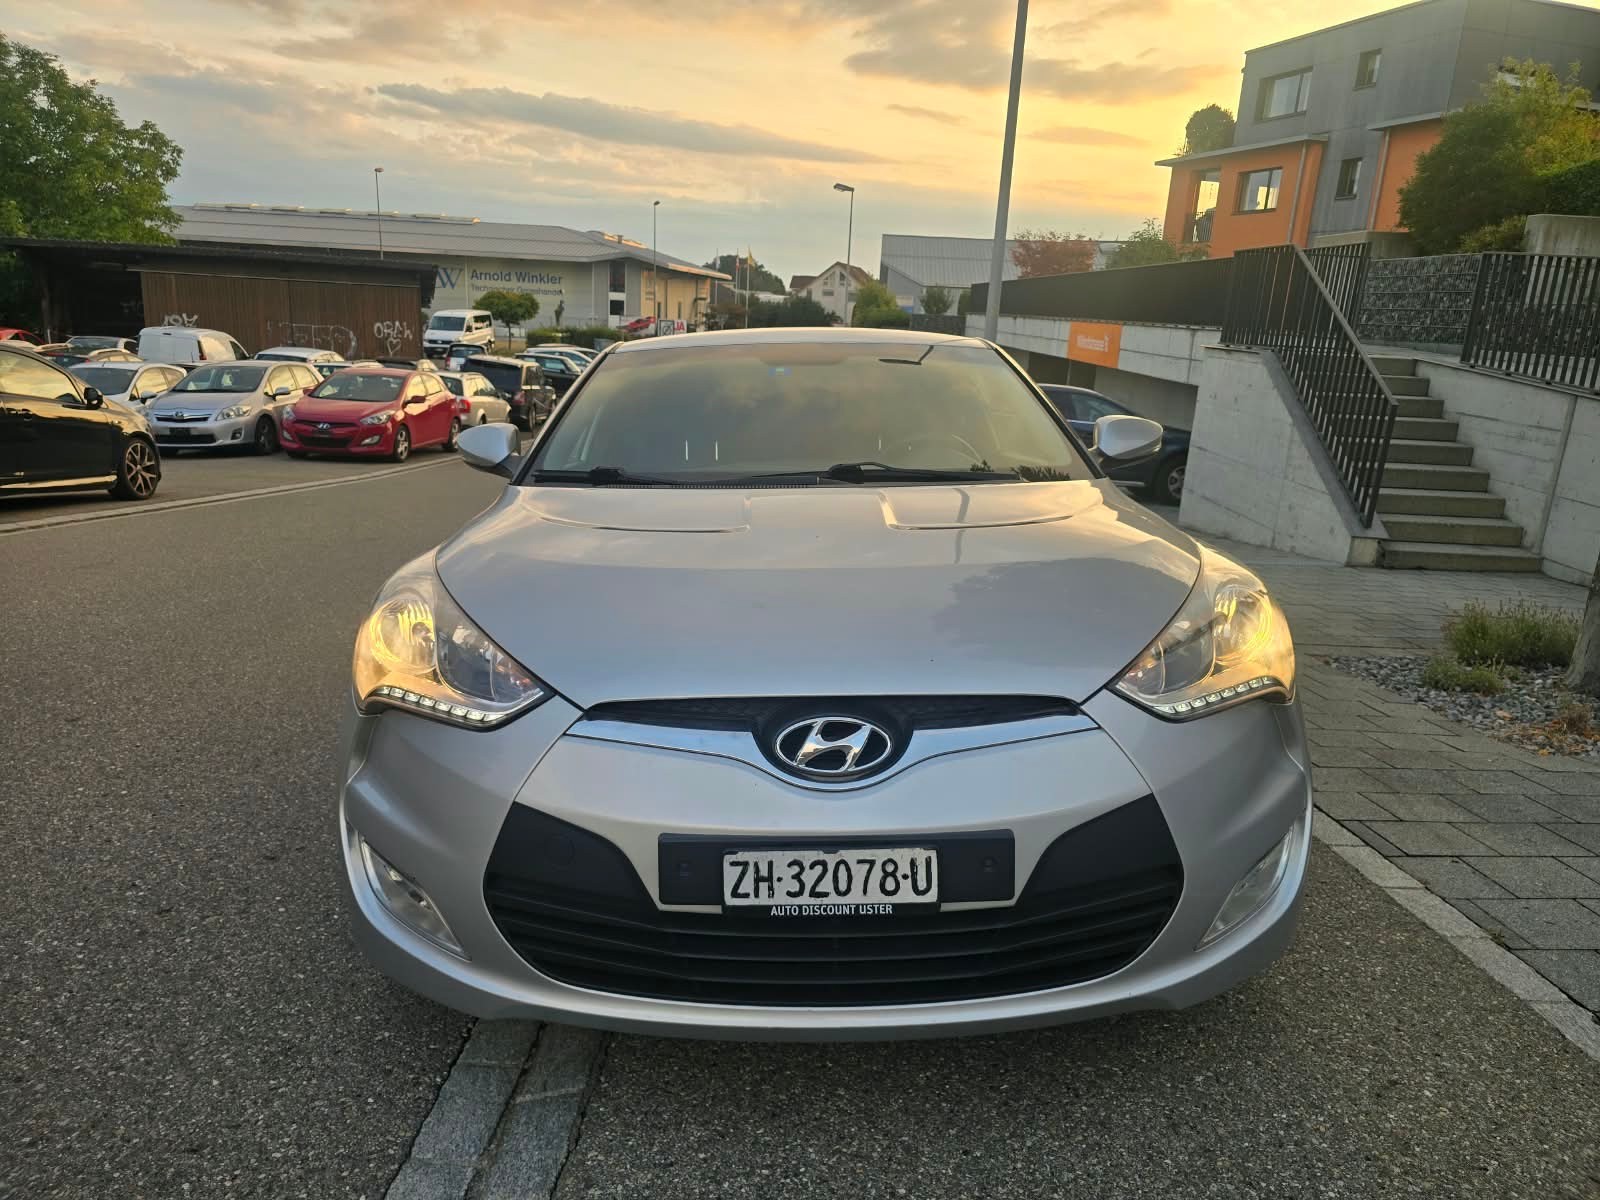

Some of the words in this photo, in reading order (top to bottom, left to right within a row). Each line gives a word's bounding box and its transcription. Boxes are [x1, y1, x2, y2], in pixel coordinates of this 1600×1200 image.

[471, 269, 511, 282] Arnold
[515, 271, 562, 285] Winkler
[770, 905, 799, 916] AUTO
[801, 904, 858, 916] DISCOUNT
[859, 904, 893, 915] USTER
